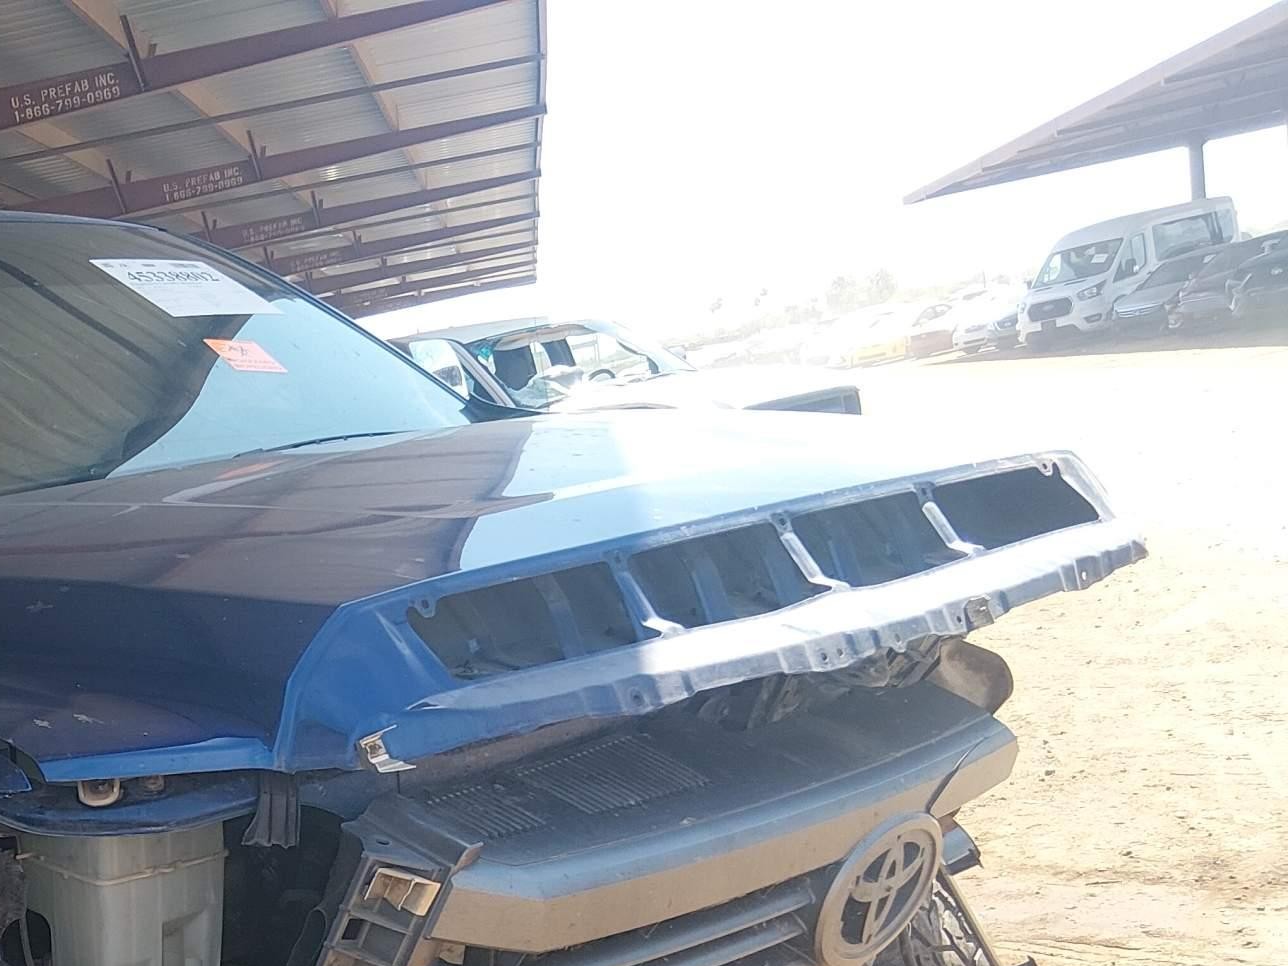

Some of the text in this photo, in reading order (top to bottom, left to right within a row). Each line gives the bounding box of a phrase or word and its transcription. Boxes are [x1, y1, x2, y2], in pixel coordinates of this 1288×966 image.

[11, 72, 120, 109] U.S. PREFAB INC.
[14, 85, 121, 123] 1-866-799-0969
[185, 170, 221, 188] PREFAB
[127, 270, 221, 282] 45338802
